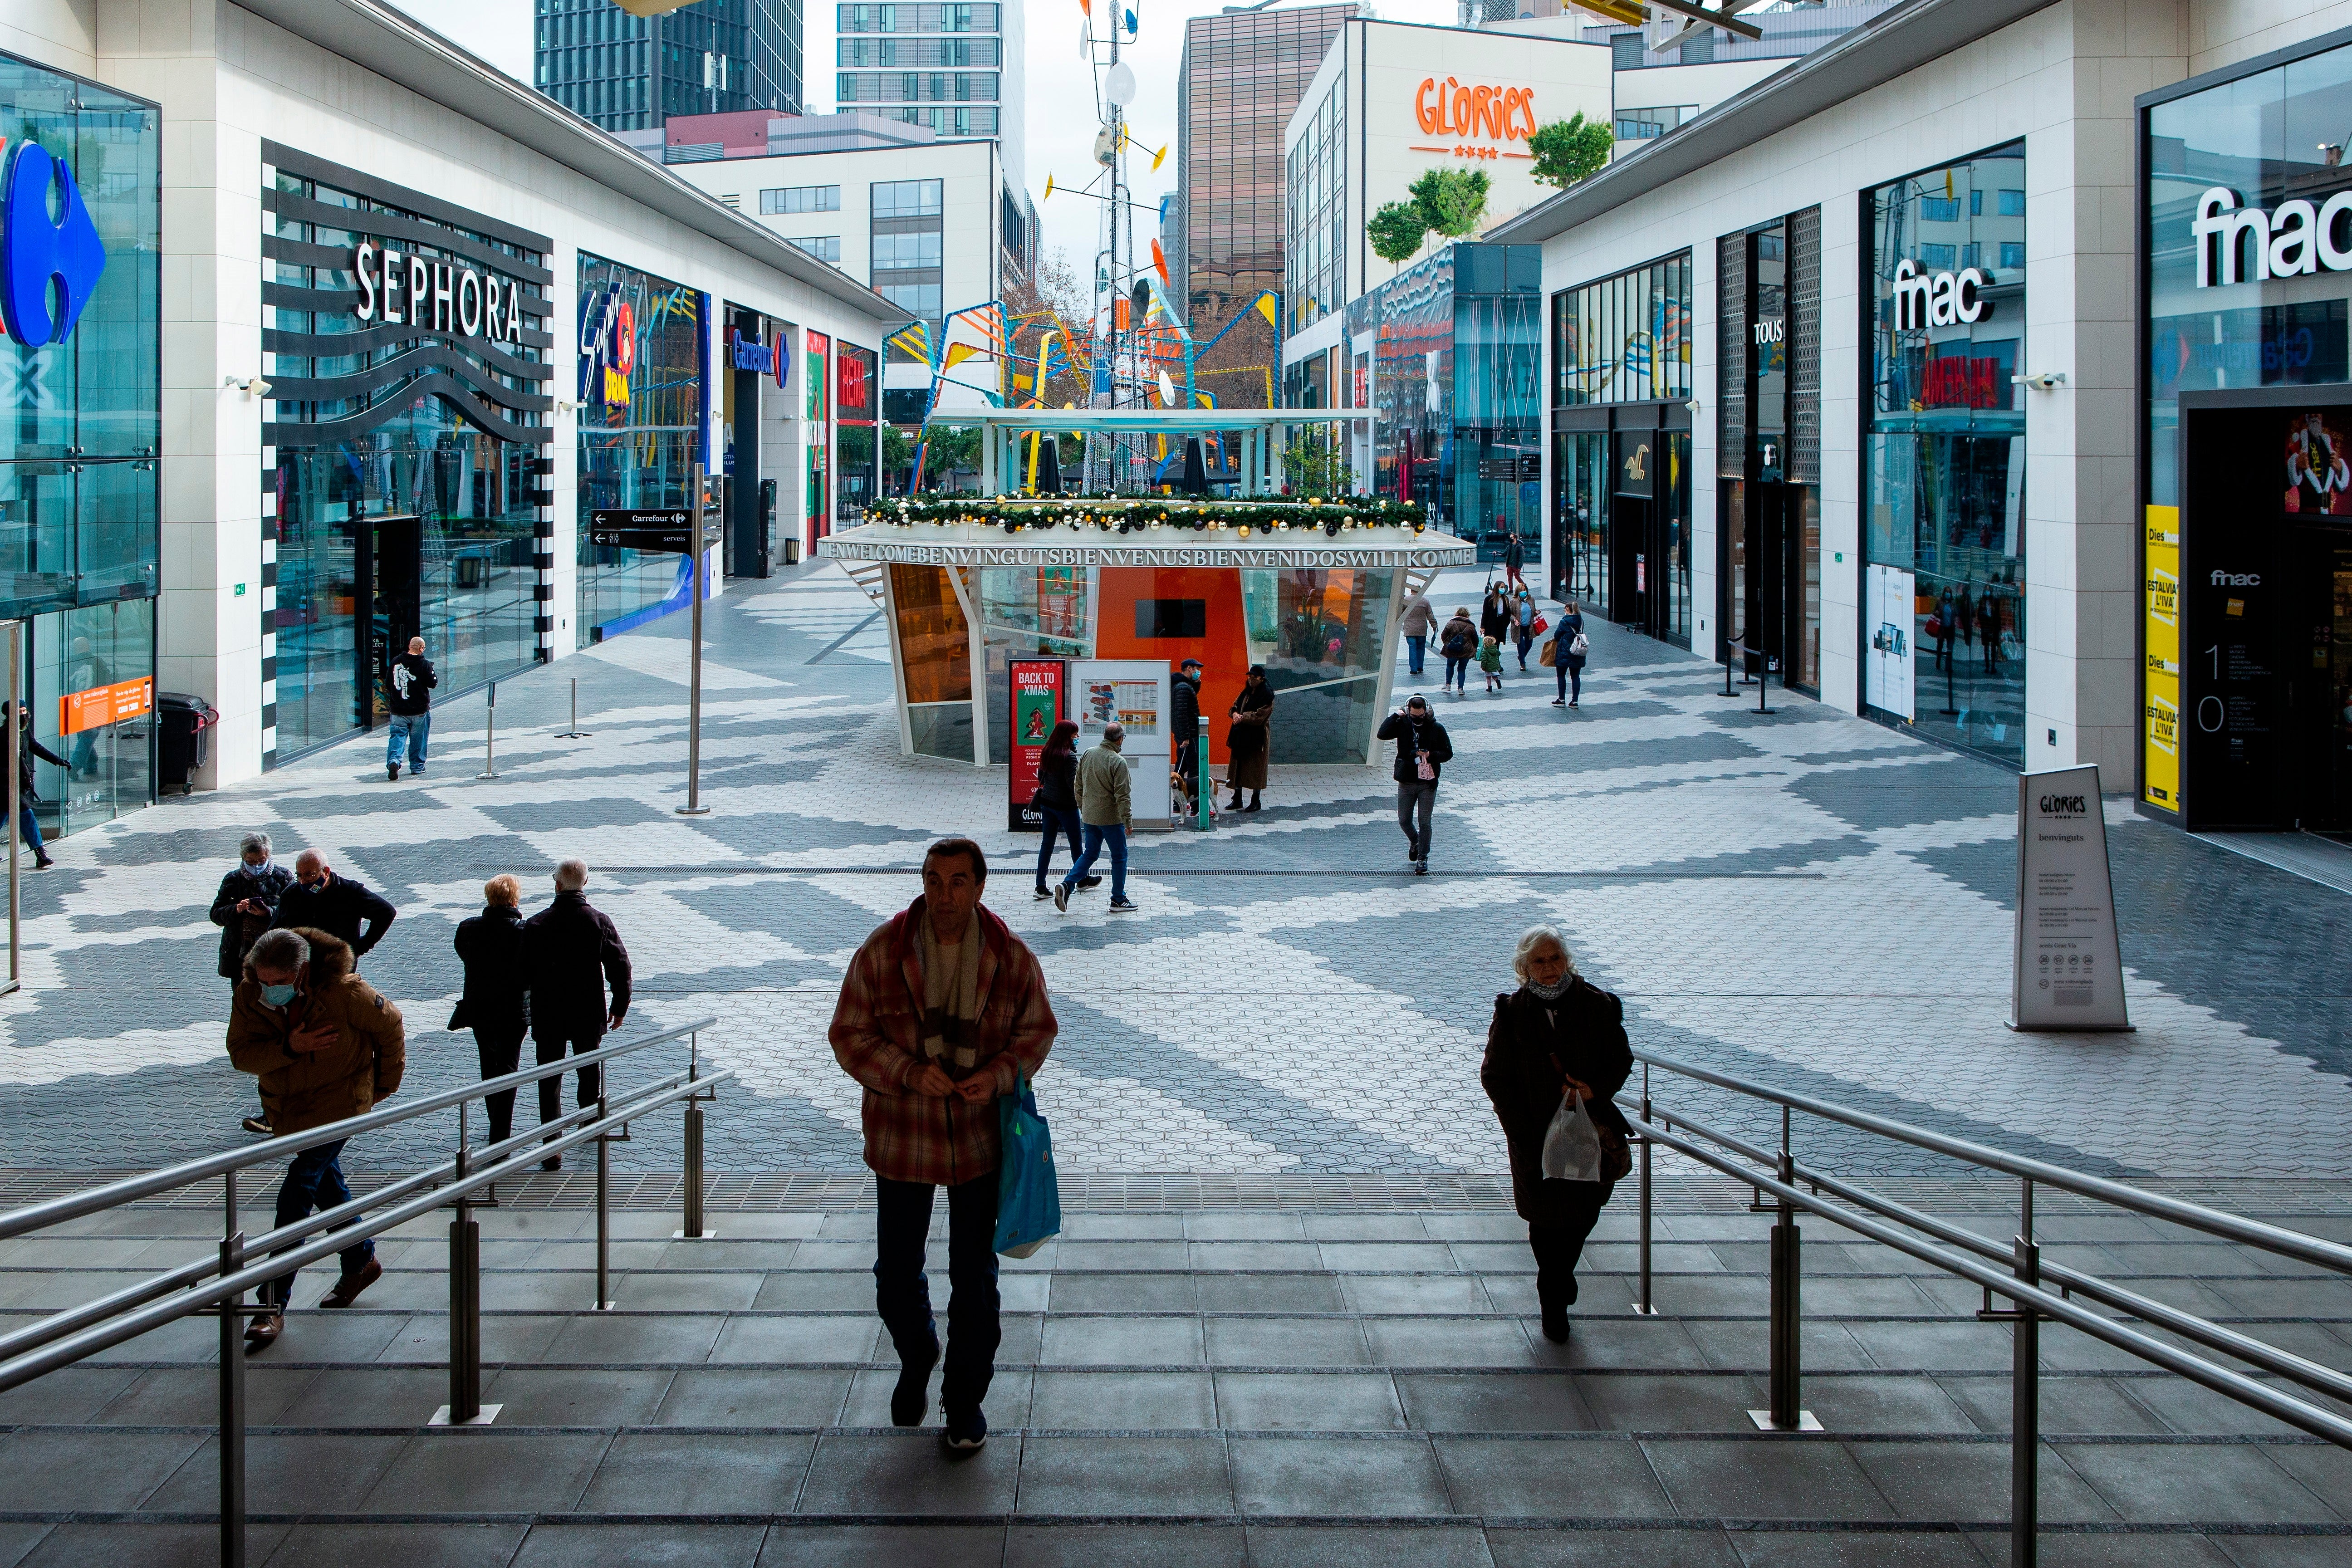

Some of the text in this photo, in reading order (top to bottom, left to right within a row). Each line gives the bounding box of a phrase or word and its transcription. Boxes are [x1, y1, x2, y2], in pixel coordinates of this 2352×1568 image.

[2192, 187, 2352, 288] fnac
[357, 243, 521, 343] SEPHORA
[1893, 259, 1983, 331] fnac
[1754, 319, 1782, 344] TOUS
[732, 329, 774, 373] Carrefour
[2310, 442, 2321, 477] fnac
[2210, 569, 2260, 586] fnac
[1019, 672, 1054, 684] BACK TO
[2205, 644, 2218, 680] 1
[1024, 684, 1049, 696] XMAS
[2039, 833, 2084, 843] benvinguts
